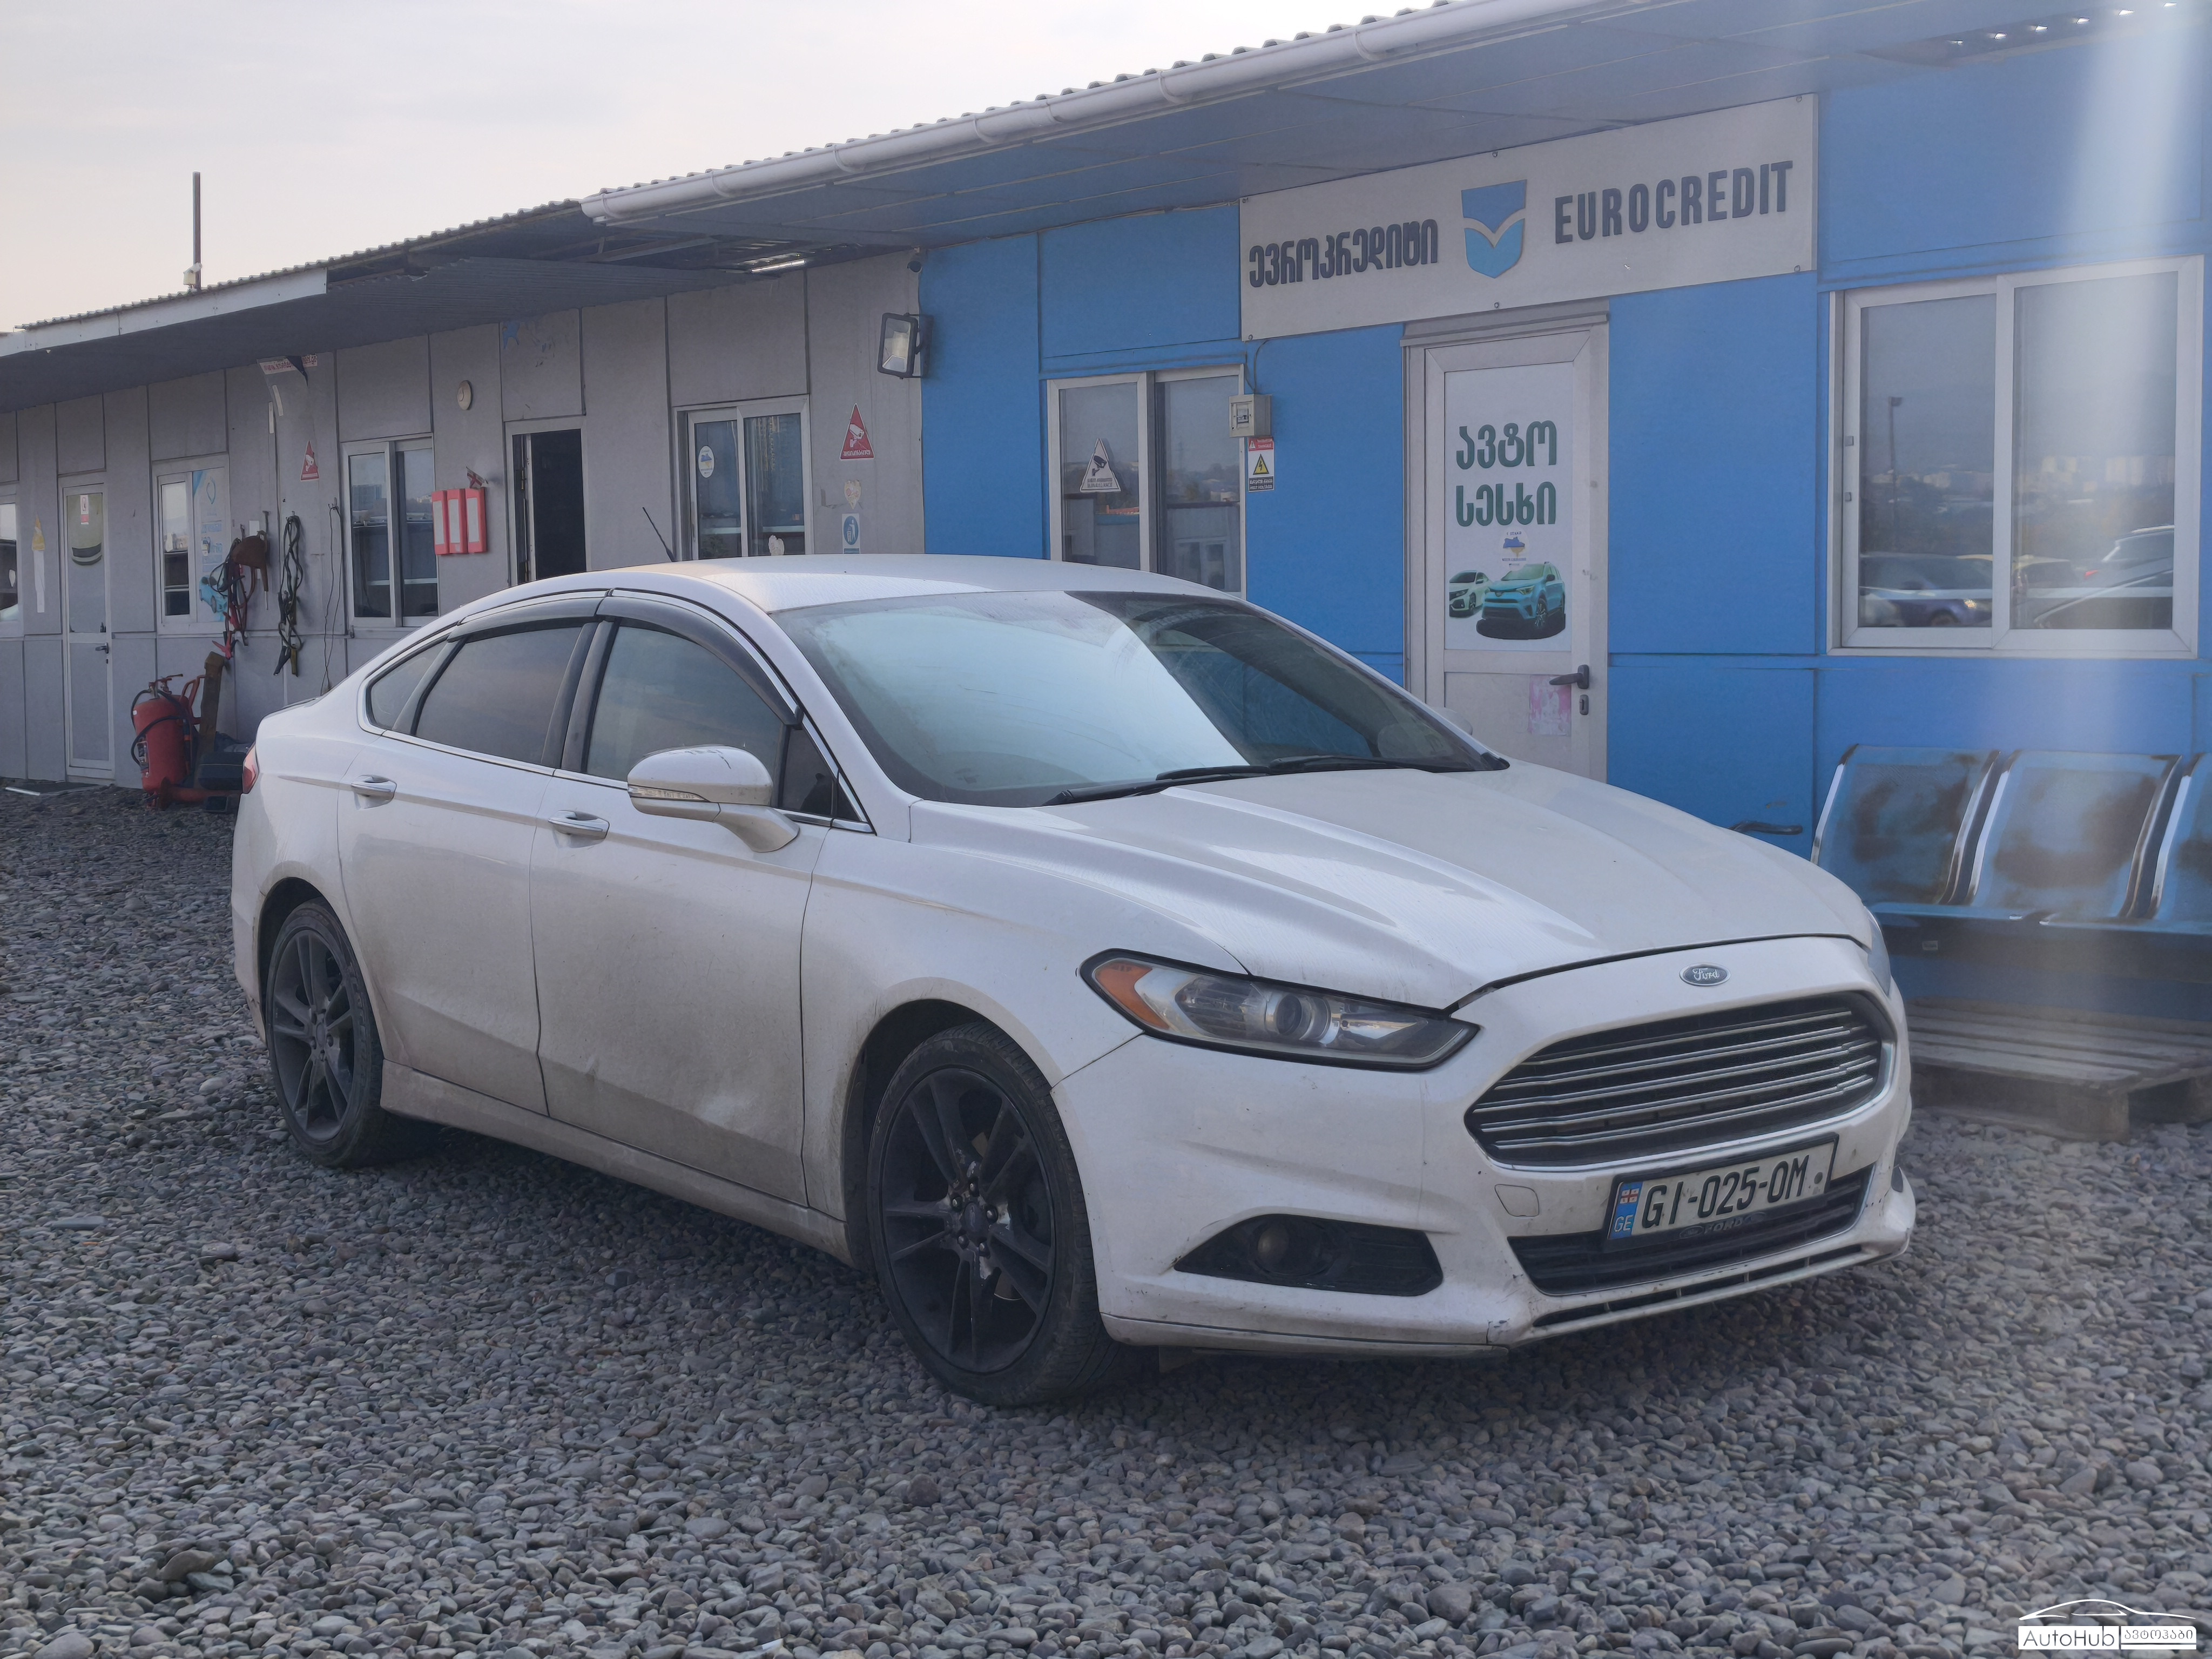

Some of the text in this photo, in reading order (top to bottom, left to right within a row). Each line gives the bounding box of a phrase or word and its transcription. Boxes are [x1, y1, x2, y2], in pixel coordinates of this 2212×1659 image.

[1555, 160, 1793, 244] EUROCREDIT
[1249, 219, 1438, 288] ევროკრედიტი
[1456, 420, 1557, 470] ავტო
[1456, 481, 1556, 527] სესხი
[1692, 967, 1720, 981] Ford
[1614, 1155, 1810, 1233] GE GI-025-OM
